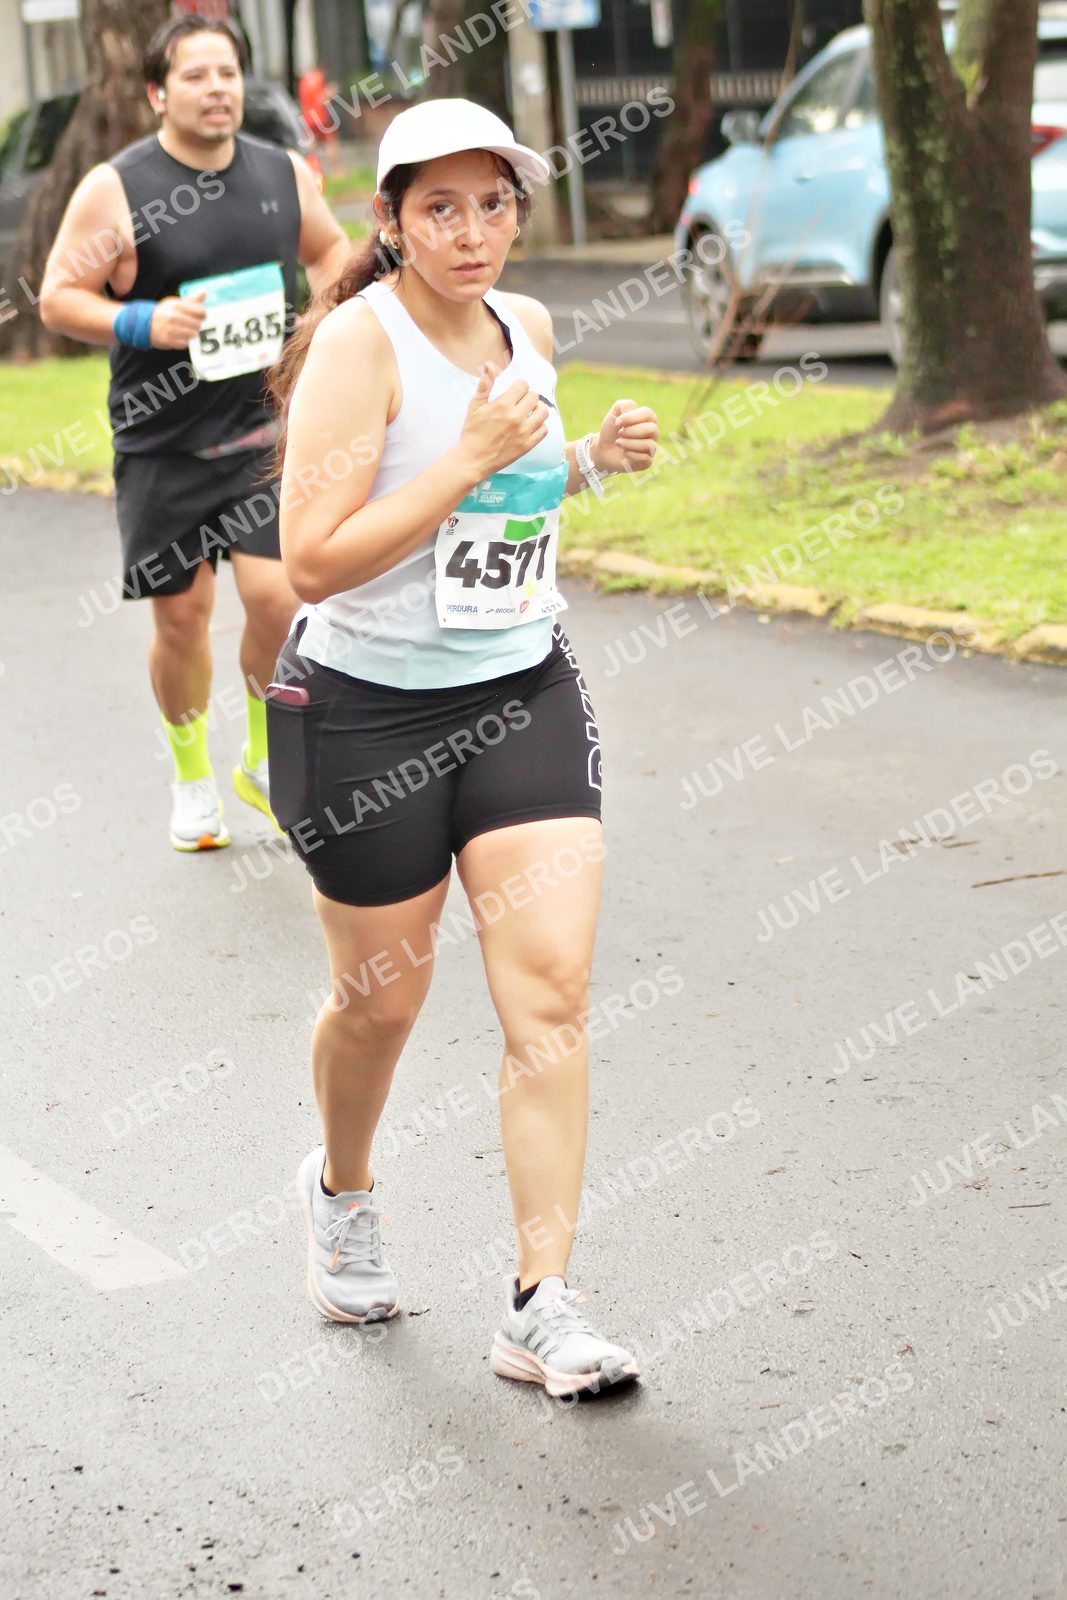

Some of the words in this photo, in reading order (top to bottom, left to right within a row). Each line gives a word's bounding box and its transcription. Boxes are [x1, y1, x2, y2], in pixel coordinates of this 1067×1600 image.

[199, 312, 282, 355] 5485
[445, 534, 550, 589] 4571
[446, 604, 478, 613] PERDURA
[541, 602, 562, 614] 4571
